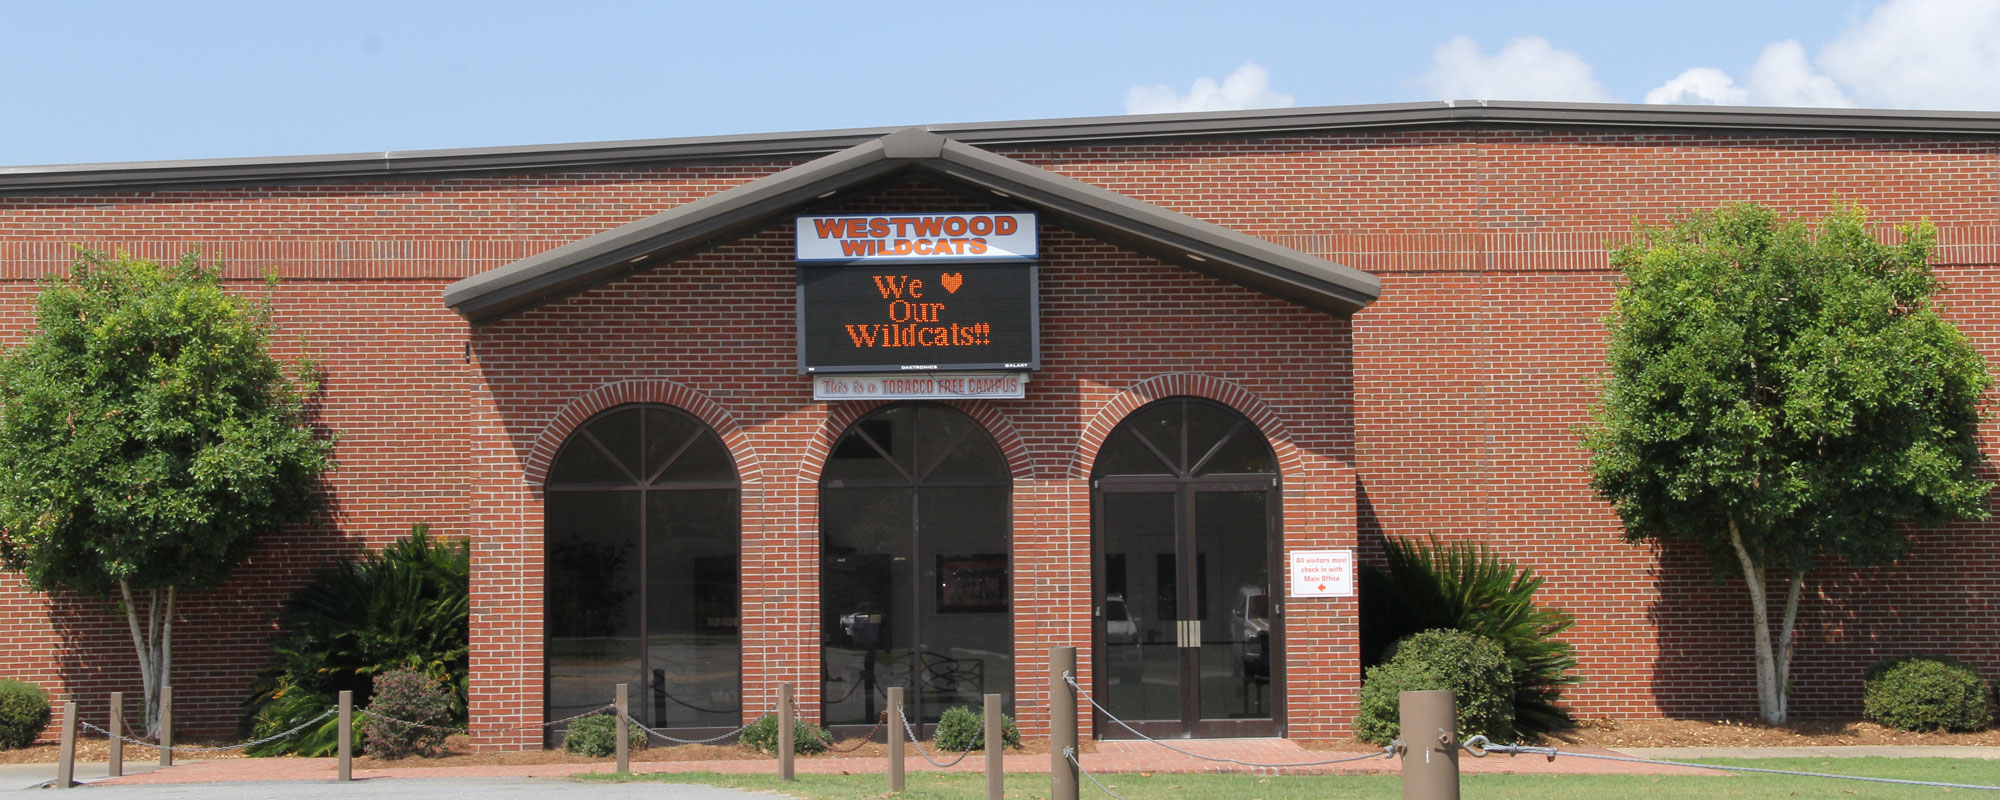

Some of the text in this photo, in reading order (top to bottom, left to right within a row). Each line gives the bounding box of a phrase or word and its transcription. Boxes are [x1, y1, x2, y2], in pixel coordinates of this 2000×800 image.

[814, 216, 1018, 239] WESTWOOD
[840, 238, 987, 257] WILDCATS
[872, 275, 923, 299] We
[889, 299, 945, 323] Our
[845, 322, 990, 348] Wildcats!!
[823, 378, 1017, 394] This is a TOBACCO FREE CAMPUS
